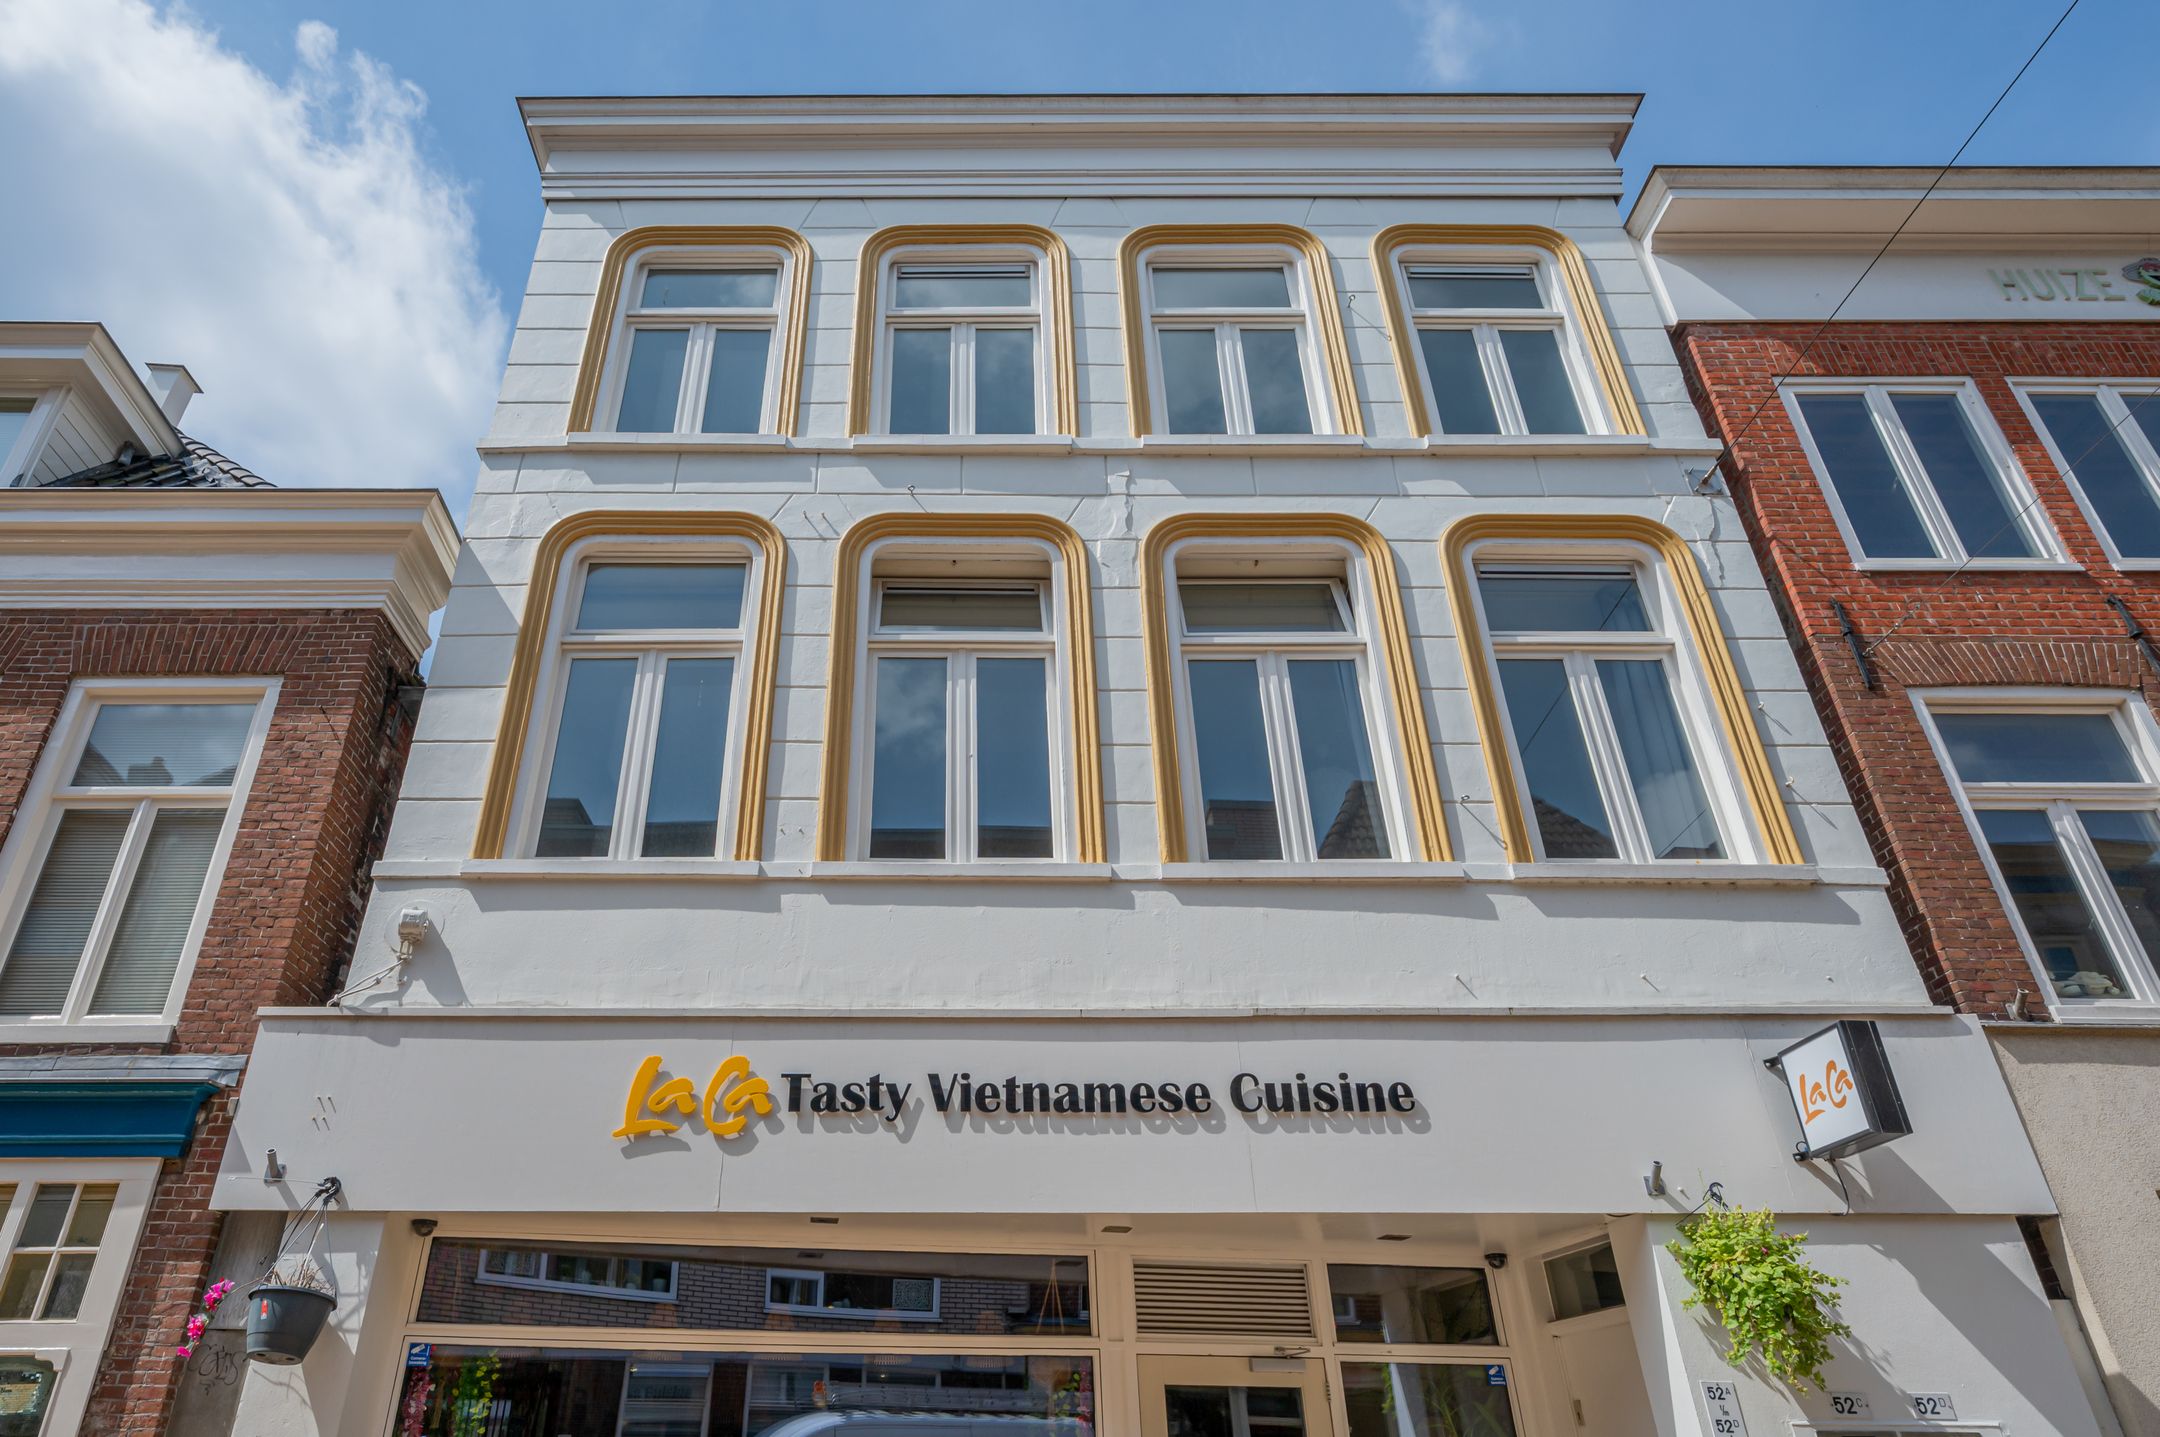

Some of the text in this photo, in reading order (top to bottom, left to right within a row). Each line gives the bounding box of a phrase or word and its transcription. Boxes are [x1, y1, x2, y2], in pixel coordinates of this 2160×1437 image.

[1986, 269, 2126, 301] HUIZE
[781, 1073, 912, 1122] Tasty
[928, 1073, 1211, 1113] Vietnamese
[1230, 1072, 1416, 1113] Cuisine
